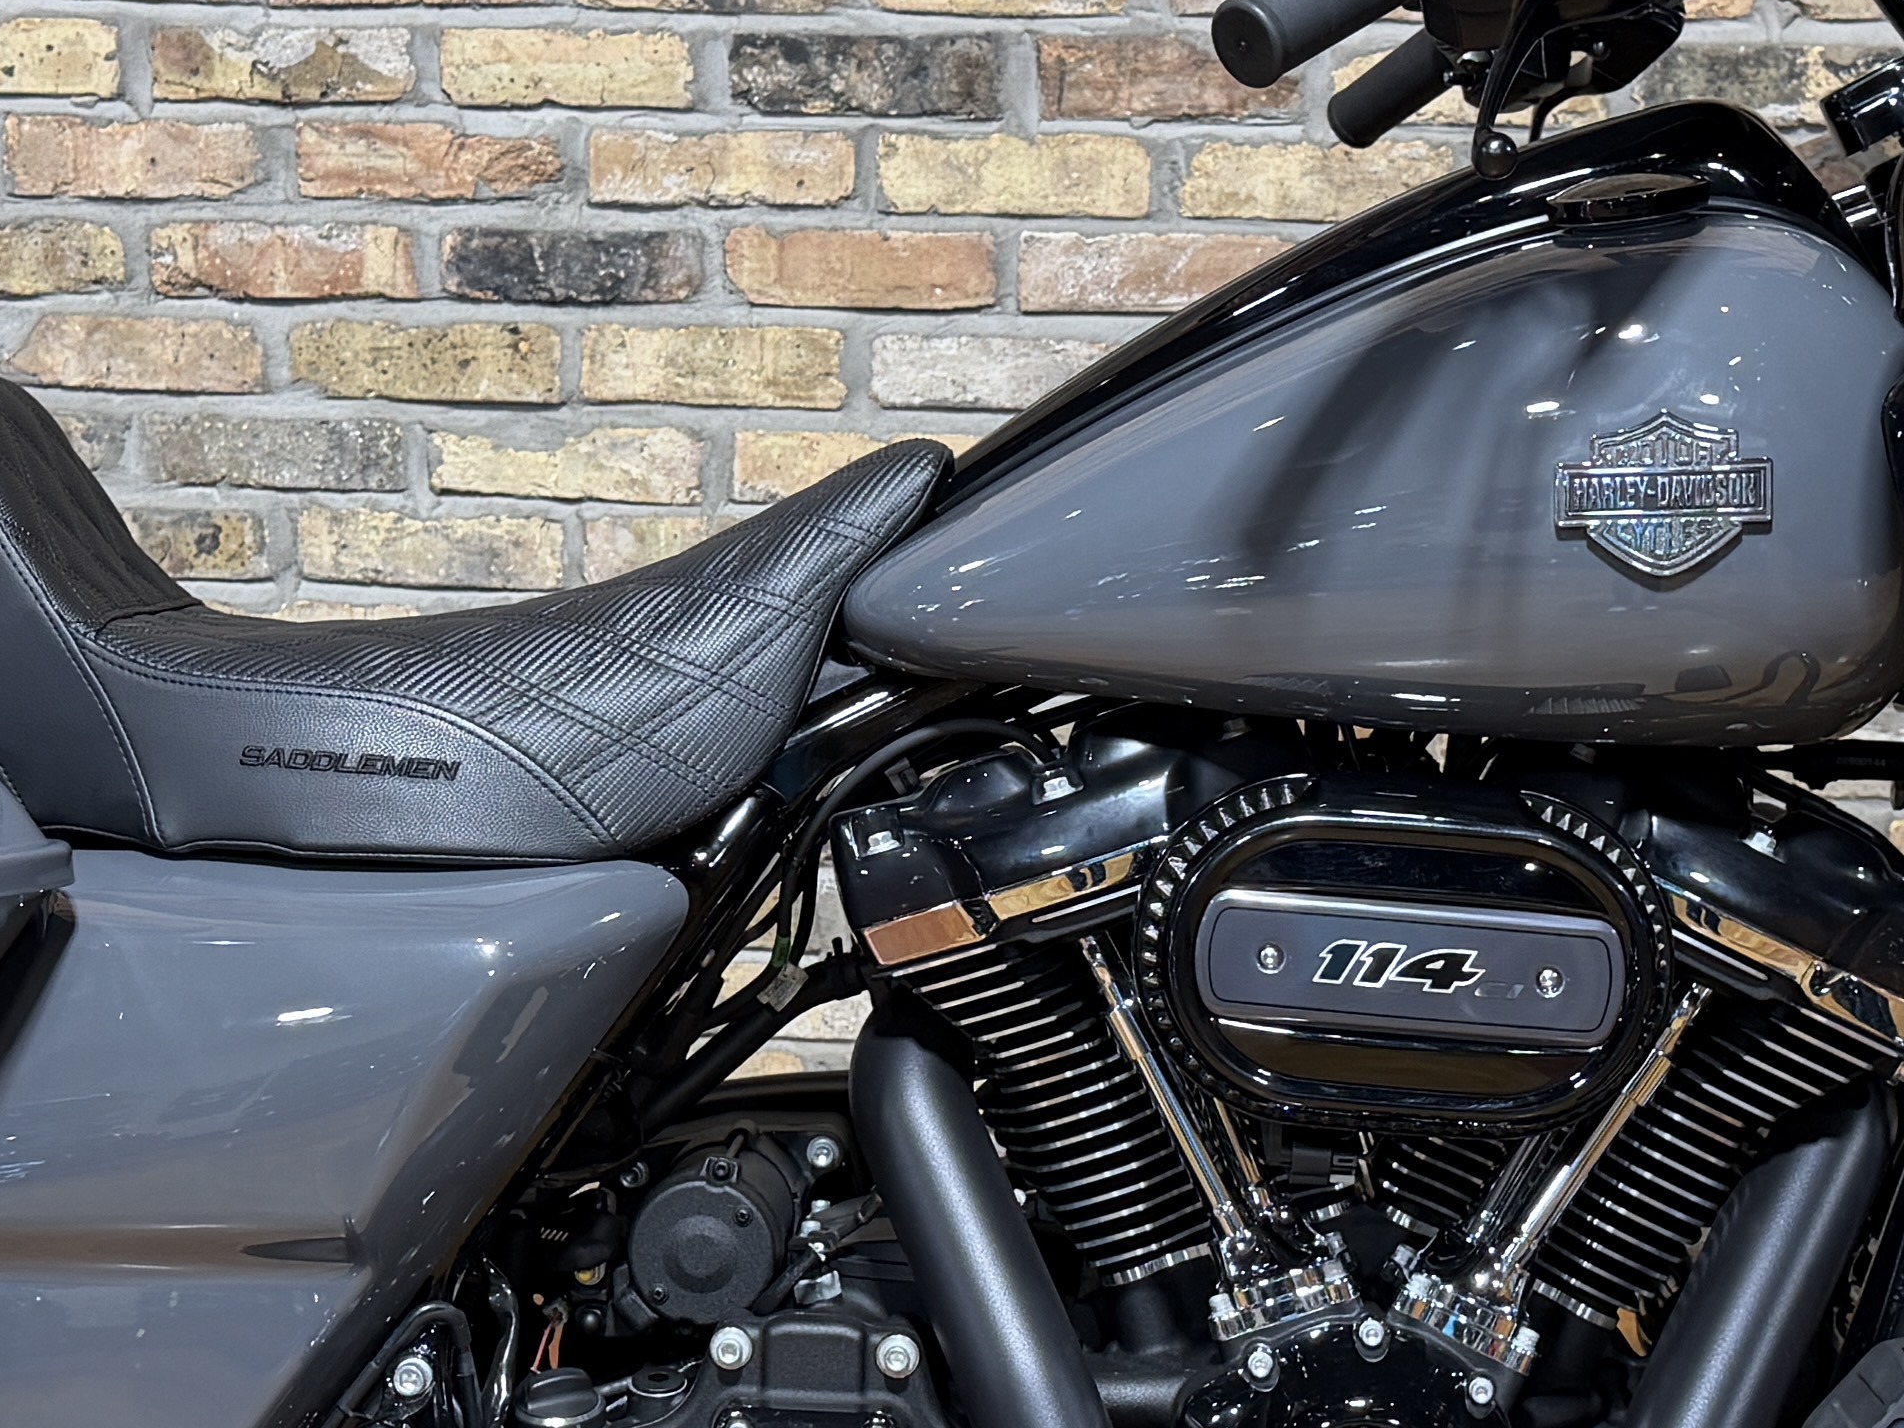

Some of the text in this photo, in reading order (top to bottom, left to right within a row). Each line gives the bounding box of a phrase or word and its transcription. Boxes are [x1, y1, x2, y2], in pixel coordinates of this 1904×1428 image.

[1572, 472, 1757, 510] HARLEY-DAVIDSON
[239, 744, 462, 782] SADDLEMEN
[1311, 938, 1487, 993] 114
